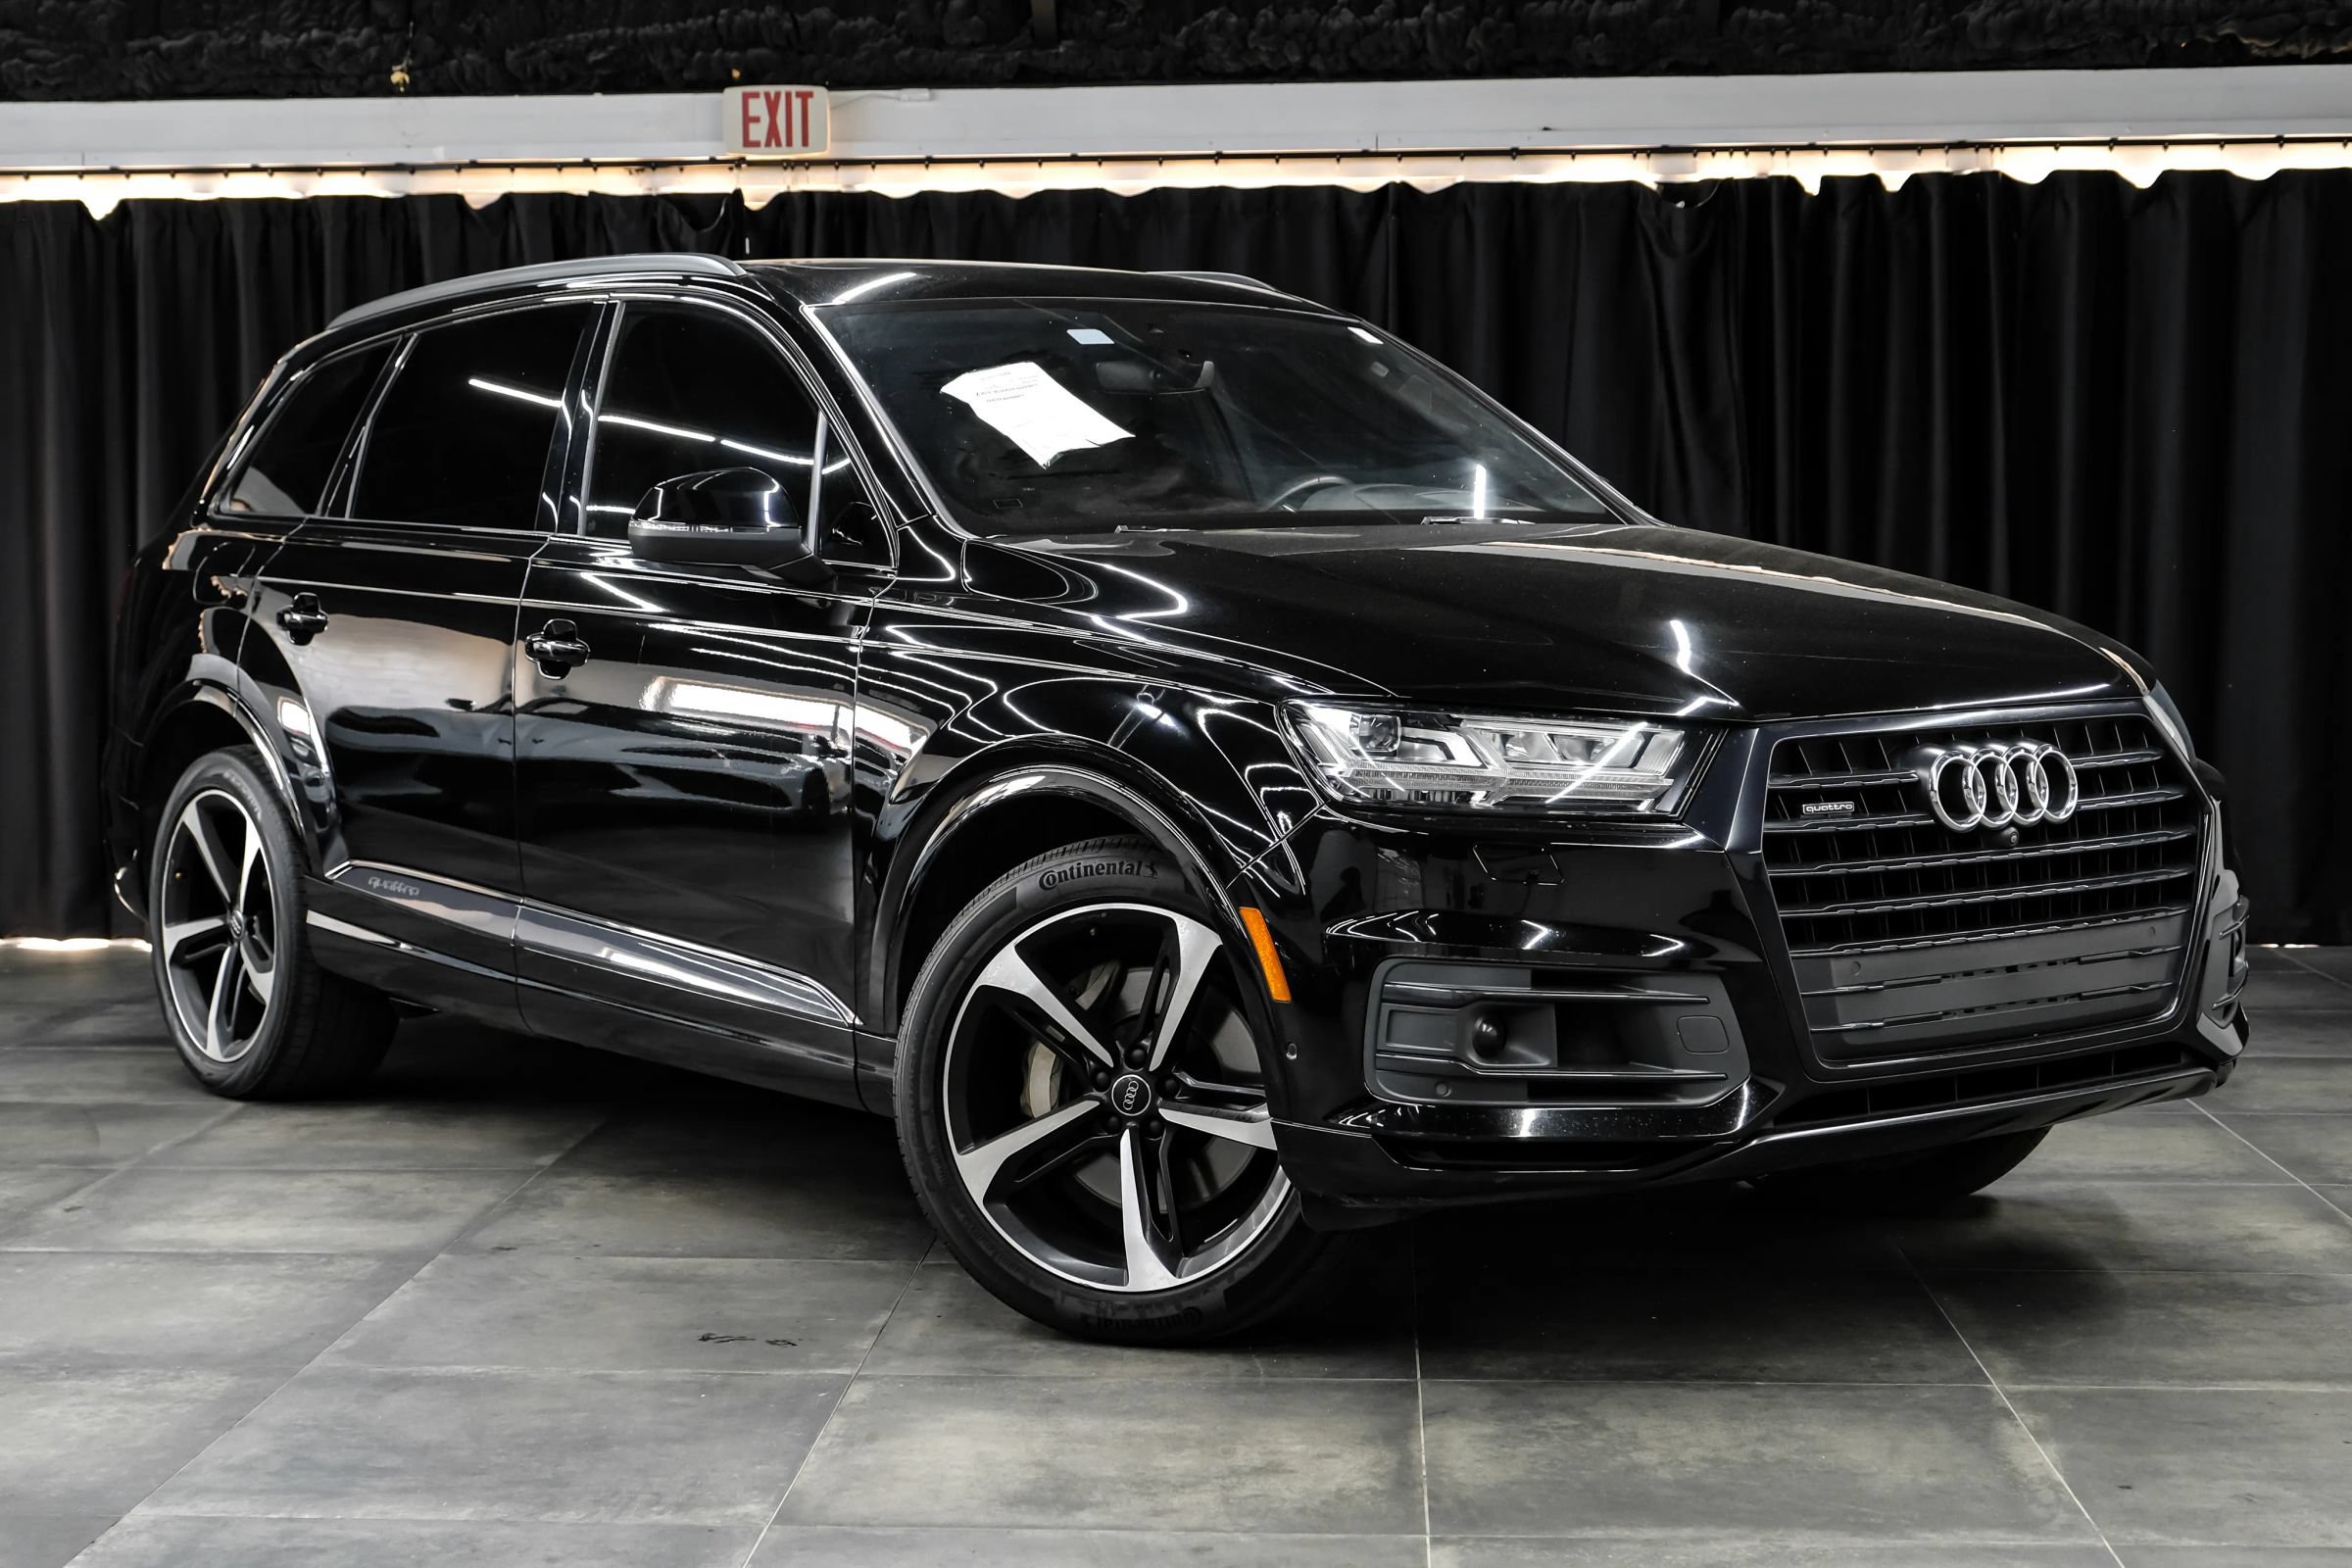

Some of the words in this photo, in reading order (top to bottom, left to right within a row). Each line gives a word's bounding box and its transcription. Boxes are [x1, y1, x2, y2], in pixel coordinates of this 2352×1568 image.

[742, 91, 813, 147] EXIT
[1805, 804, 1853, 812] quattro
[368, 876, 419, 896] quattro
[1039, 861, 1143, 891] Continental
